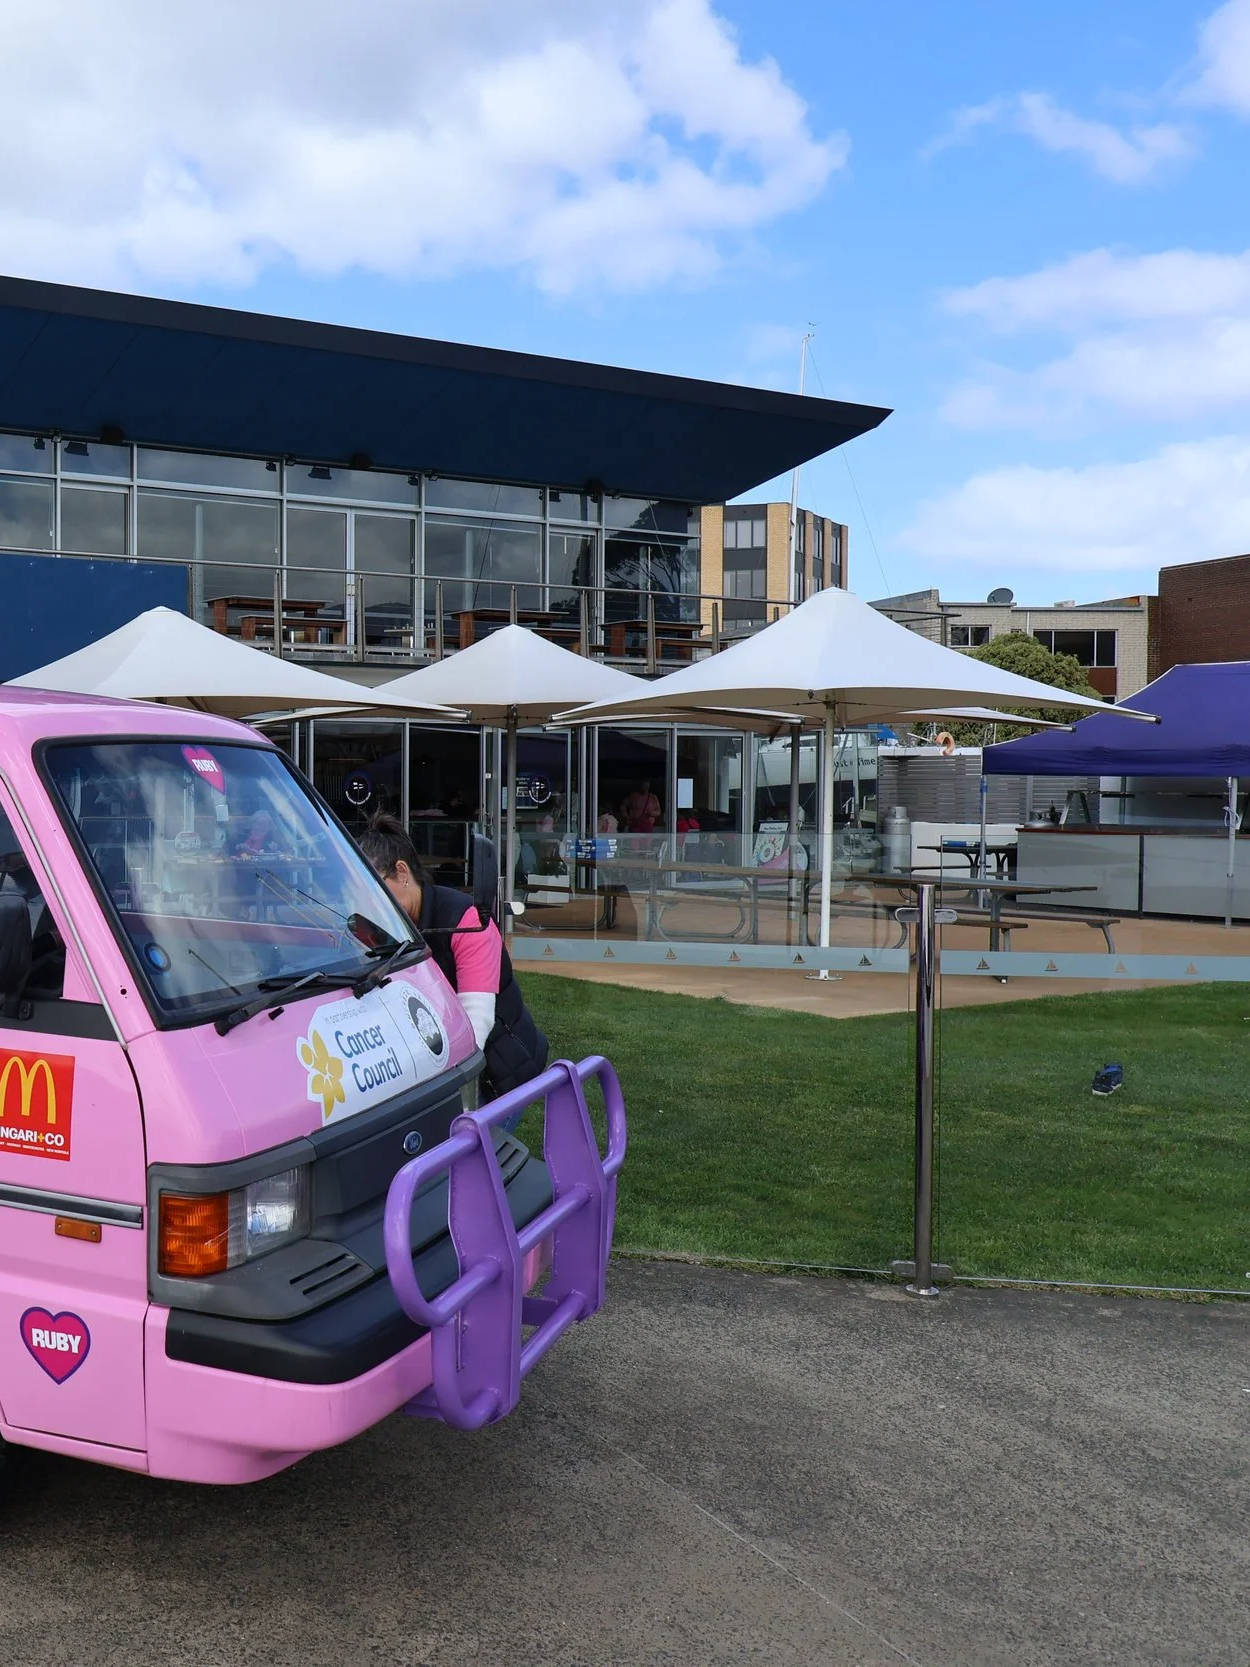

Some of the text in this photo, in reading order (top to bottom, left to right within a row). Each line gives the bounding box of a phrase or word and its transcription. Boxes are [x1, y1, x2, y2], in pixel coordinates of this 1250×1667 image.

[191, 759, 219, 772] RUBY
[334, 1024, 386, 1059] Cancer
[351, 1046, 403, 1093] Council
[31, 1327, 82, 1354] RUBY
